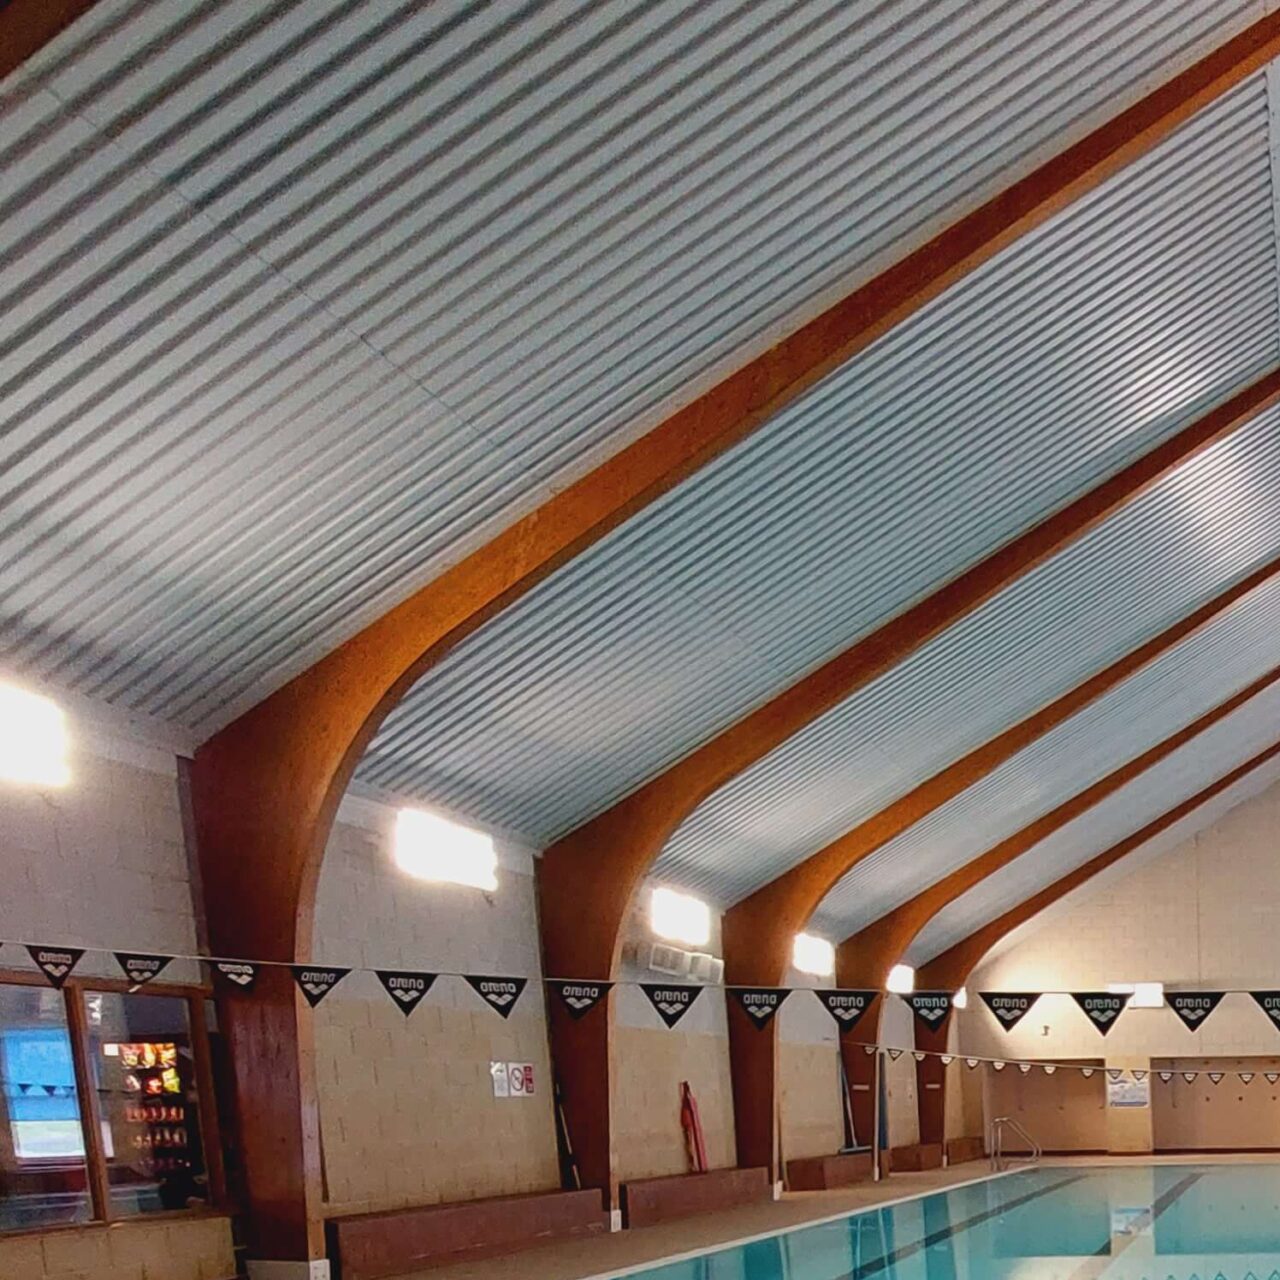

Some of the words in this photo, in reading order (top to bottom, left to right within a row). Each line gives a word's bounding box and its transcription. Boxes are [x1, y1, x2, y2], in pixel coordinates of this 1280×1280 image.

[301, 972, 337, 983] arena
[388, 976, 424, 989] arena
[480, 981, 517, 993] arena
[562, 985, 599, 998] arena
[654, 990, 689, 1002] arena
[743, 993, 777, 1005] arena
[828, 995, 865, 1007] arena
[913, 996, 948, 1008] arena
[992, 998, 1028, 1009] arena
[1084, 998, 1120, 1009] arena
[1175, 997, 1210, 1008] arena
